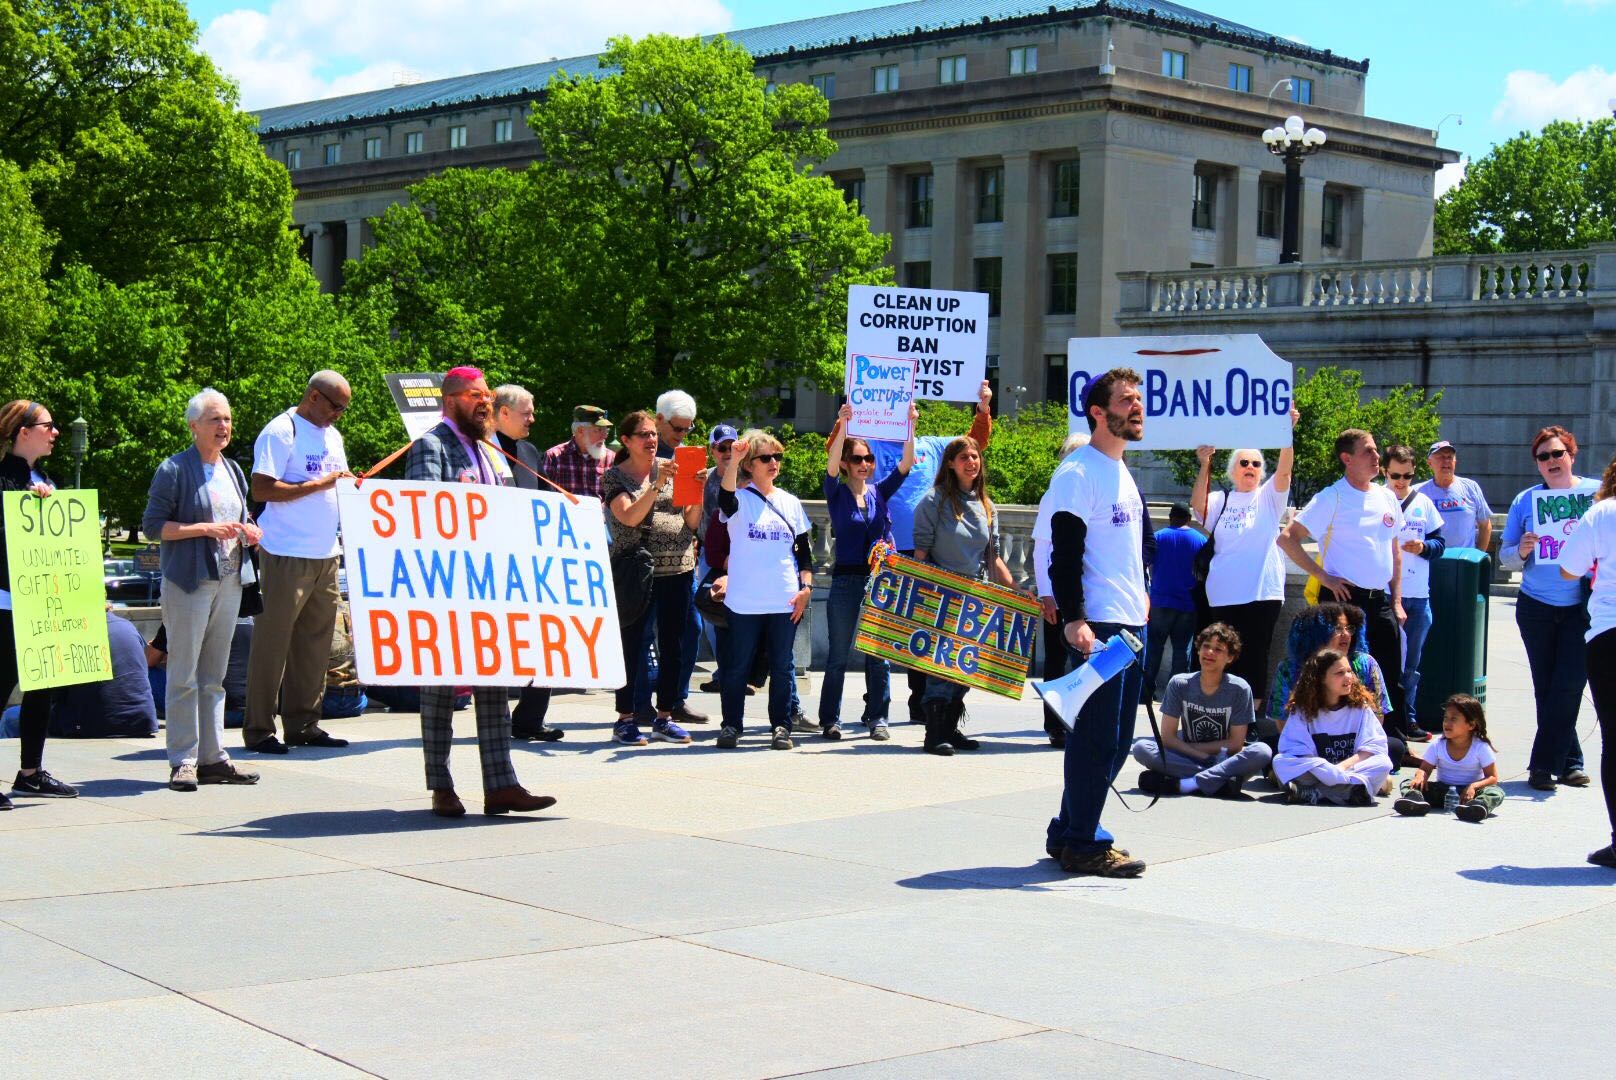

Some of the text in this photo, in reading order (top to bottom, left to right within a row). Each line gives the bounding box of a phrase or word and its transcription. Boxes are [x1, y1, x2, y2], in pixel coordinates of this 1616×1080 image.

[873, 293, 960, 313] CLEAN UP
[859, 312, 976, 334] CORRUPTION
[897, 336, 938, 354] BAN
[855, 355, 911, 385] Power
[850, 386, 913, 409] Corrupts
[20, 494, 86, 537] STOP
[370, 489, 591, 550] STOP PA.
[22, 548, 90, 568] UNLIMITED
[65, 573, 81, 593] TO
[358, 547, 608, 608] LAWMAKER
[46, 597, 64, 618] PA
[369, 609, 604, 679] BRIBERY
[1183, 700, 1206, 713] STAR
